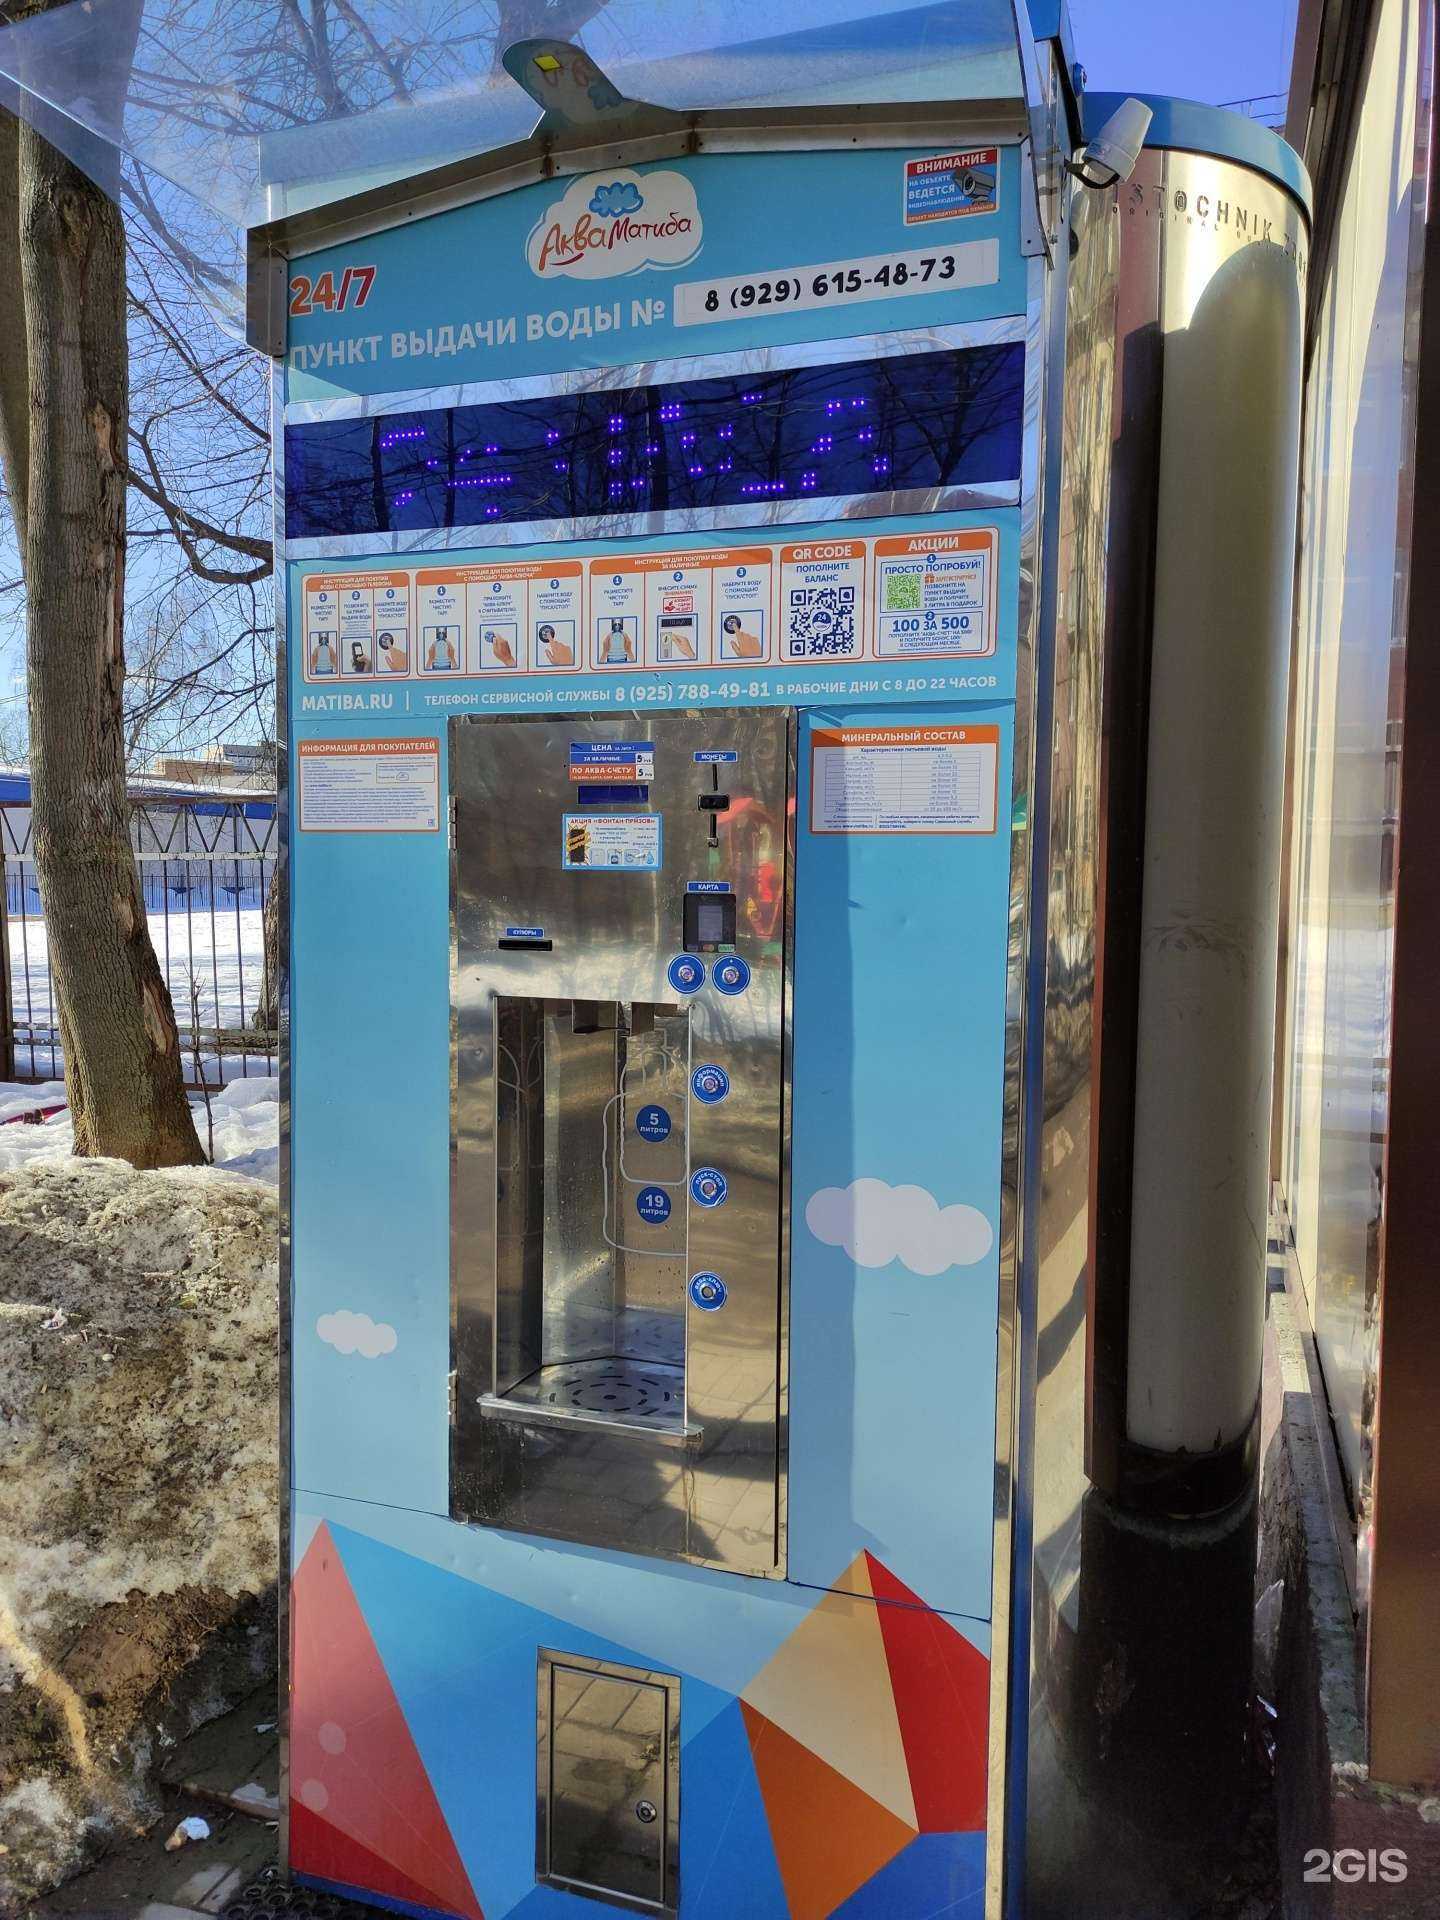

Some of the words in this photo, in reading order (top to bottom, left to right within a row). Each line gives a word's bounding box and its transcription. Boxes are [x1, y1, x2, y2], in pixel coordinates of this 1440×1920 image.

[916, 152, 988, 174] ВНИМАНИЕ
[908, 184, 956, 200] ВЕДЕТСЯ
[289, 265, 377, 317] 24/7
[289, 335, 384, 371] ПУНКТ
[391, 316, 516, 360] ВЫДАЧИ
[526, 302, 621, 342] ВОДЫ
[704, 289, 719, 312] 8
[730, 278, 800, 310] (929)
[812, 255, 956, 297] 615-48-73
[907, 536, 959, 552] АКЦИИ
[792, 547, 812, 560] QR
[814, 545, 853, 558] CODE
[796, 562, 850, 573] ПОПОЛНИТЕ
[884, 564, 924, 575] ПРОСТО
[925, 560, 981, 572] ПОПРОБУЙ!
[804, 574, 839, 583] БАЛАНС
[892, 619, 920, 633] 100
[923, 620, 937, 631] ЗА
[941, 616, 970, 630] 500
[424, 693, 479, 706] ТЕЛЕФОН
[481, 689, 554, 704] СЕРВИСНОЙ
[556, 689, 610, 702] СЛУЖБЫ
[615, 686, 625, 702] 8
[630, 682, 673, 703] (925)
[678, 681, 770, 700] 788-49-81
[776, 684, 784, 695] В
[787, 681, 847, 695] РАБОЧИЕ
[850, 681, 879, 694] ДНИ
[882, 680, 891, 691] С
[894, 679, 903, 690] 8
[906, 678, 927, 691] ДО
[930, 678, 946, 689] 22
[949, 675, 997, 689] ЧАСОВ
[301, 693, 393, 711] MATIBA.RU
[841, 730, 921, 743] МИНЕРАЛЬНЫЙ
[923, 730, 966, 740] СОСТАВ
[301, 744, 358, 753] ИНФОРМАЦИЯ
[359, 743, 376, 753] ДЛЯ
[377, 740, 436, 751] ПОКУПАТЕЛЕЙ
[591, 744, 612, 752] ЦЕНА
[636, 754, 643, 763] 5
[638, 768, 644, 777] 5
[698, 883, 719, 891] КАРТА
[649, 1113, 660, 1125] 5
[640, 1125, 668, 1134] литров
[645, 1195, 665, 1208] 19
[640, 1207, 668, 1216] литров
